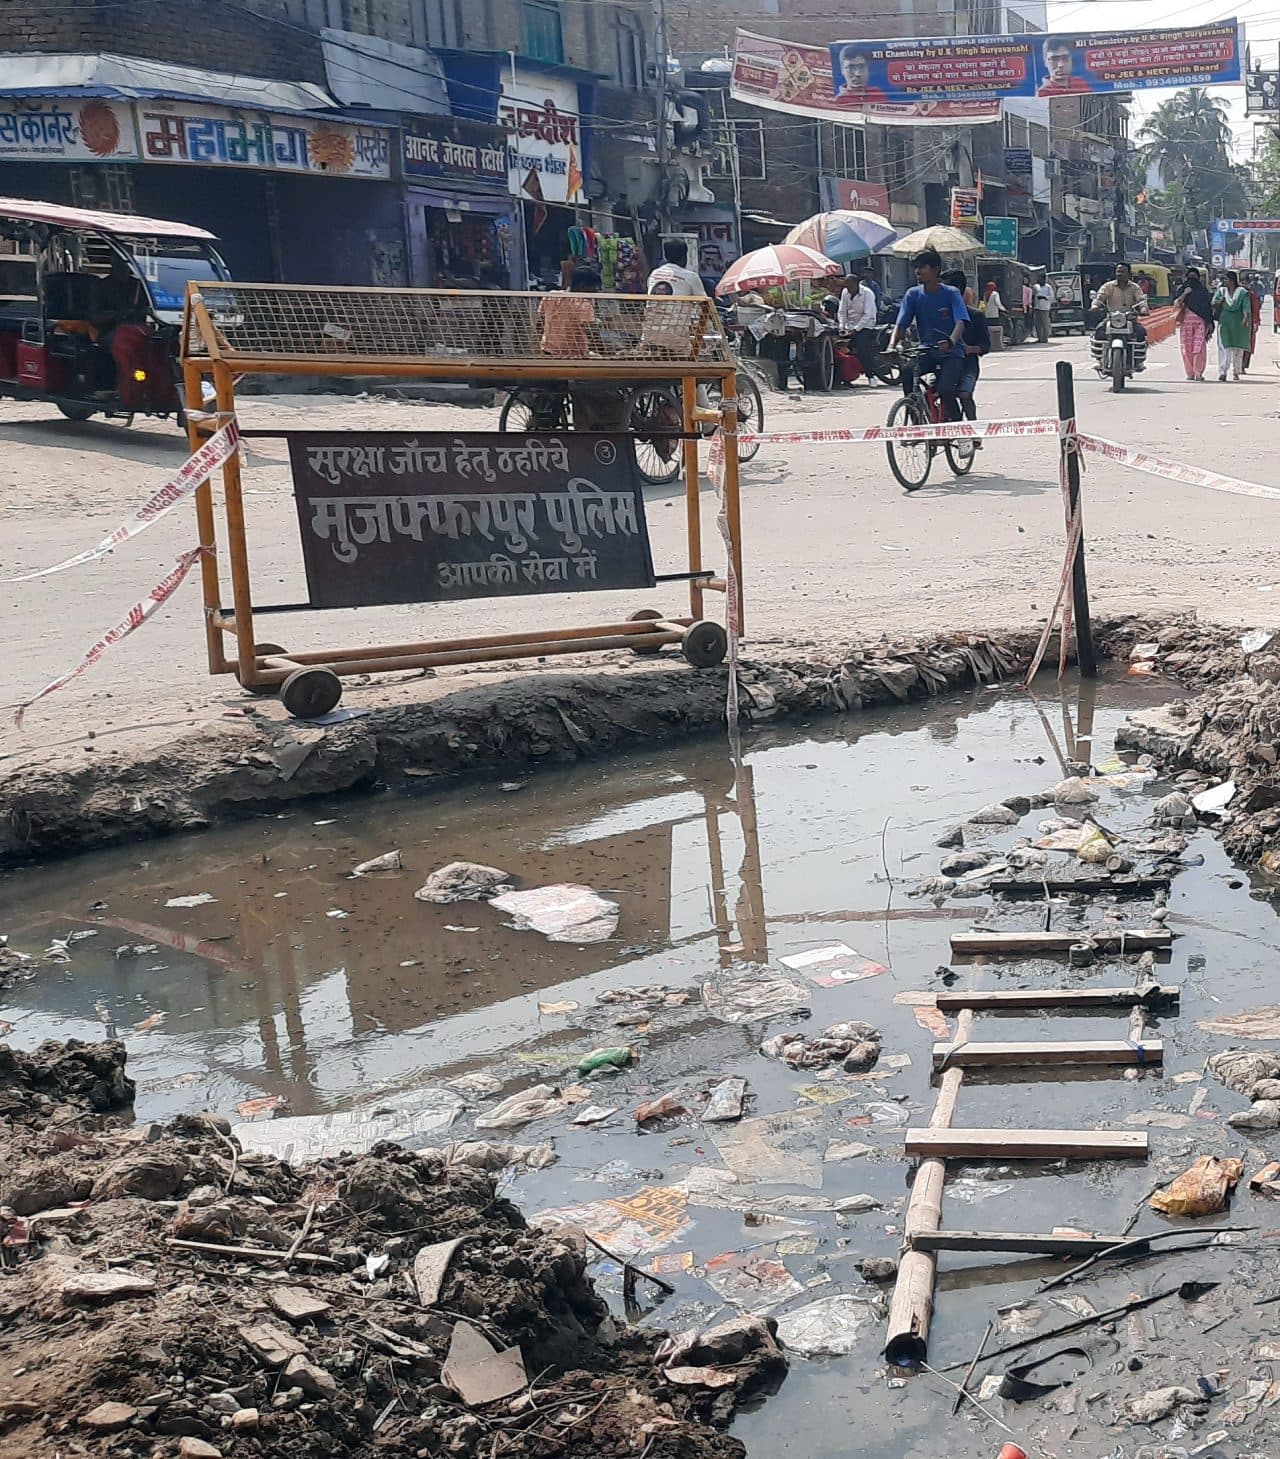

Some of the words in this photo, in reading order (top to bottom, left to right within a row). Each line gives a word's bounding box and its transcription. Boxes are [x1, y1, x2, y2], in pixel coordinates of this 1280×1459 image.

[872, 50, 884, 59] XII
[885, 49, 925, 59] Chemistry
[926, 48, 936, 58] by
[955, 46, 979, 56] Singh
[980, 44, 1029, 55] Suryavanshi
[1088, 37, 1128, 47] Chemistry
[1129, 36, 1140, 45] by
[1159, 32, 1183, 42] Singh
[1184, 26, 1234, 39] Suryavanshi
[1104, 71, 1116, 79] Do
[1146, 68, 1170, 77] NEET
[1172, 66, 1192, 74] with
[1193, 63, 1220, 72] Board
[1145, 74, 1212, 87] 9934980559
[144, 108, 311, 171] महाभोग
[442, 136, 478, 170] जेनरल
[480, 143, 505, 172] स्टोर्स
[193, 457, 220, 482] WORK
[306, 446, 385, 485] सुरक्षा
[453, 439, 495, 483] हेतु
[496, 438, 570, 475] ठहरिये
[136, 483, 176, 520] CAUTION
[180, 455, 200, 477] MEN
[540, 477, 639, 555] पुलिस
[437, 552, 518, 588] आपकी
[520, 550, 569, 584] सेवा
[572, 547, 598, 580] में
[85, 640, 105, 661] MEN
